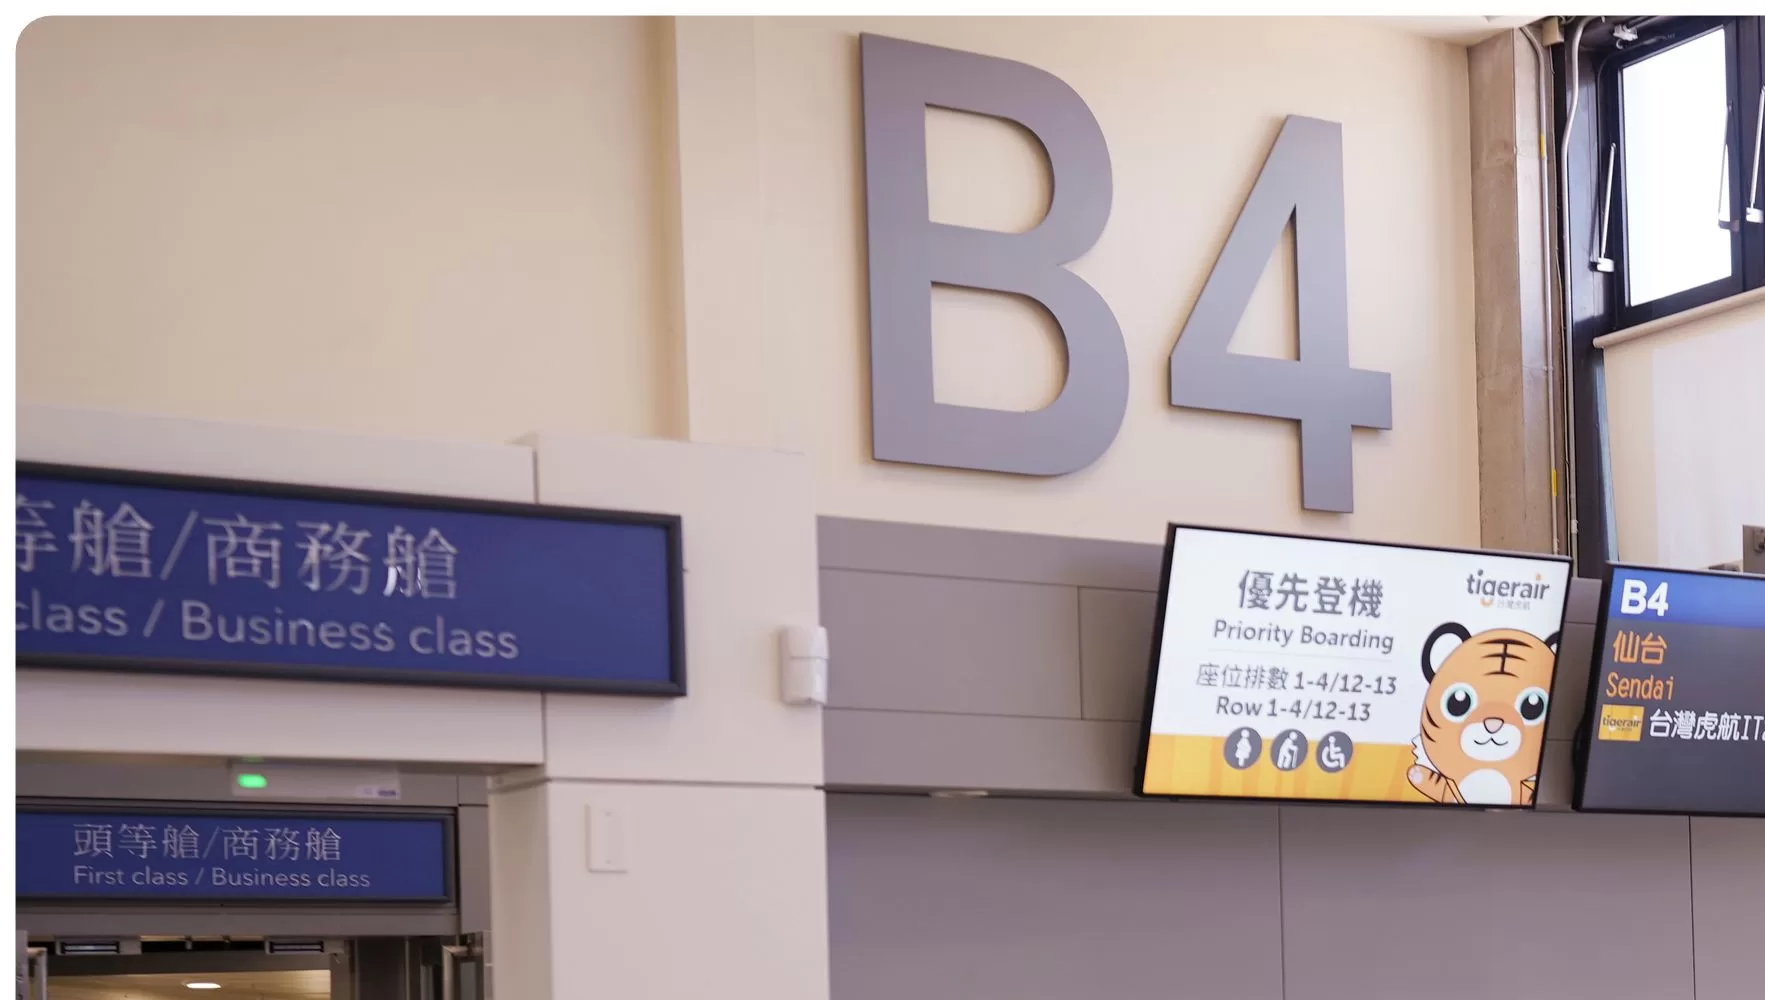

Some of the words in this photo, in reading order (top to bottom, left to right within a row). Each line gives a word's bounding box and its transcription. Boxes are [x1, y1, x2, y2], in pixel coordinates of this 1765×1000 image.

[860, 31, 1392, 513] B4
[1238, 569, 1385, 619] 優先登機
[1467, 569, 1550, 607] tigerair
[1620, 578, 1669, 617] B4
[181, 599, 396, 652] Business
[409, 616, 520, 659] class
[1213, 619, 1294, 650] Priority
[1299, 625, 1395, 655] Boarding
[1612, 630, 1668, 665] 仙台
[1196, 663, 1289, 692] 座位排數
[1293, 670, 1398, 696] 1-4/12-13
[1606, 672, 1675, 701] Sendai
[1215, 696, 1262, 718] Row
[1267, 698, 1372, 722] 1-4/12-13
[73, 823, 342, 862] 頭等艙/商務艙
[74, 865, 125, 886] First
[132, 865, 189, 886] class
[212, 867, 311, 888] Business
[317, 868, 371, 888] class
